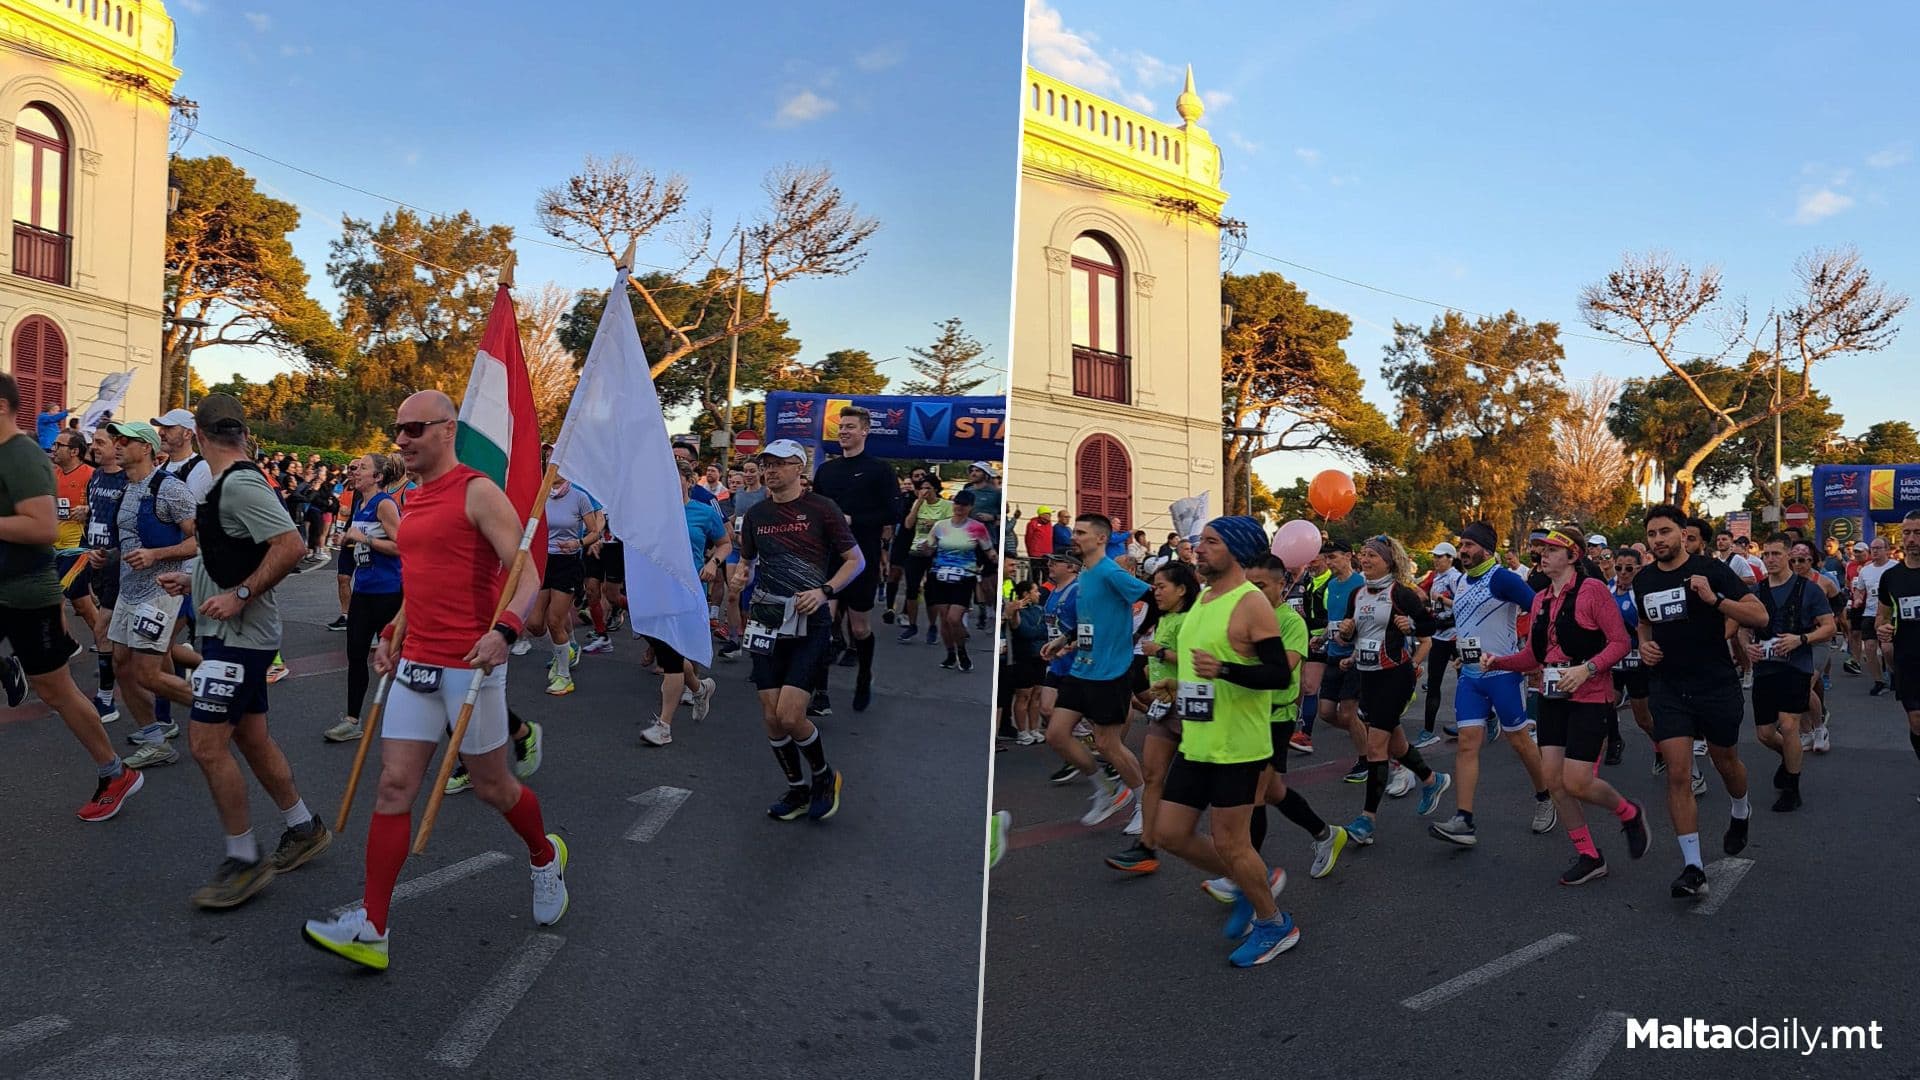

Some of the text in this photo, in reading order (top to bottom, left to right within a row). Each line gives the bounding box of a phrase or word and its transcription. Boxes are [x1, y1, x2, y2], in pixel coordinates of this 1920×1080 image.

[757, 522, 810, 535] HUNGARY
[1664, 603, 1683, 616] 866
[753, 638, 770, 649] 464
[1464, 650, 1479, 659] 163
[208, 682, 235, 697] 262
[194, 701, 227, 713] adidas
